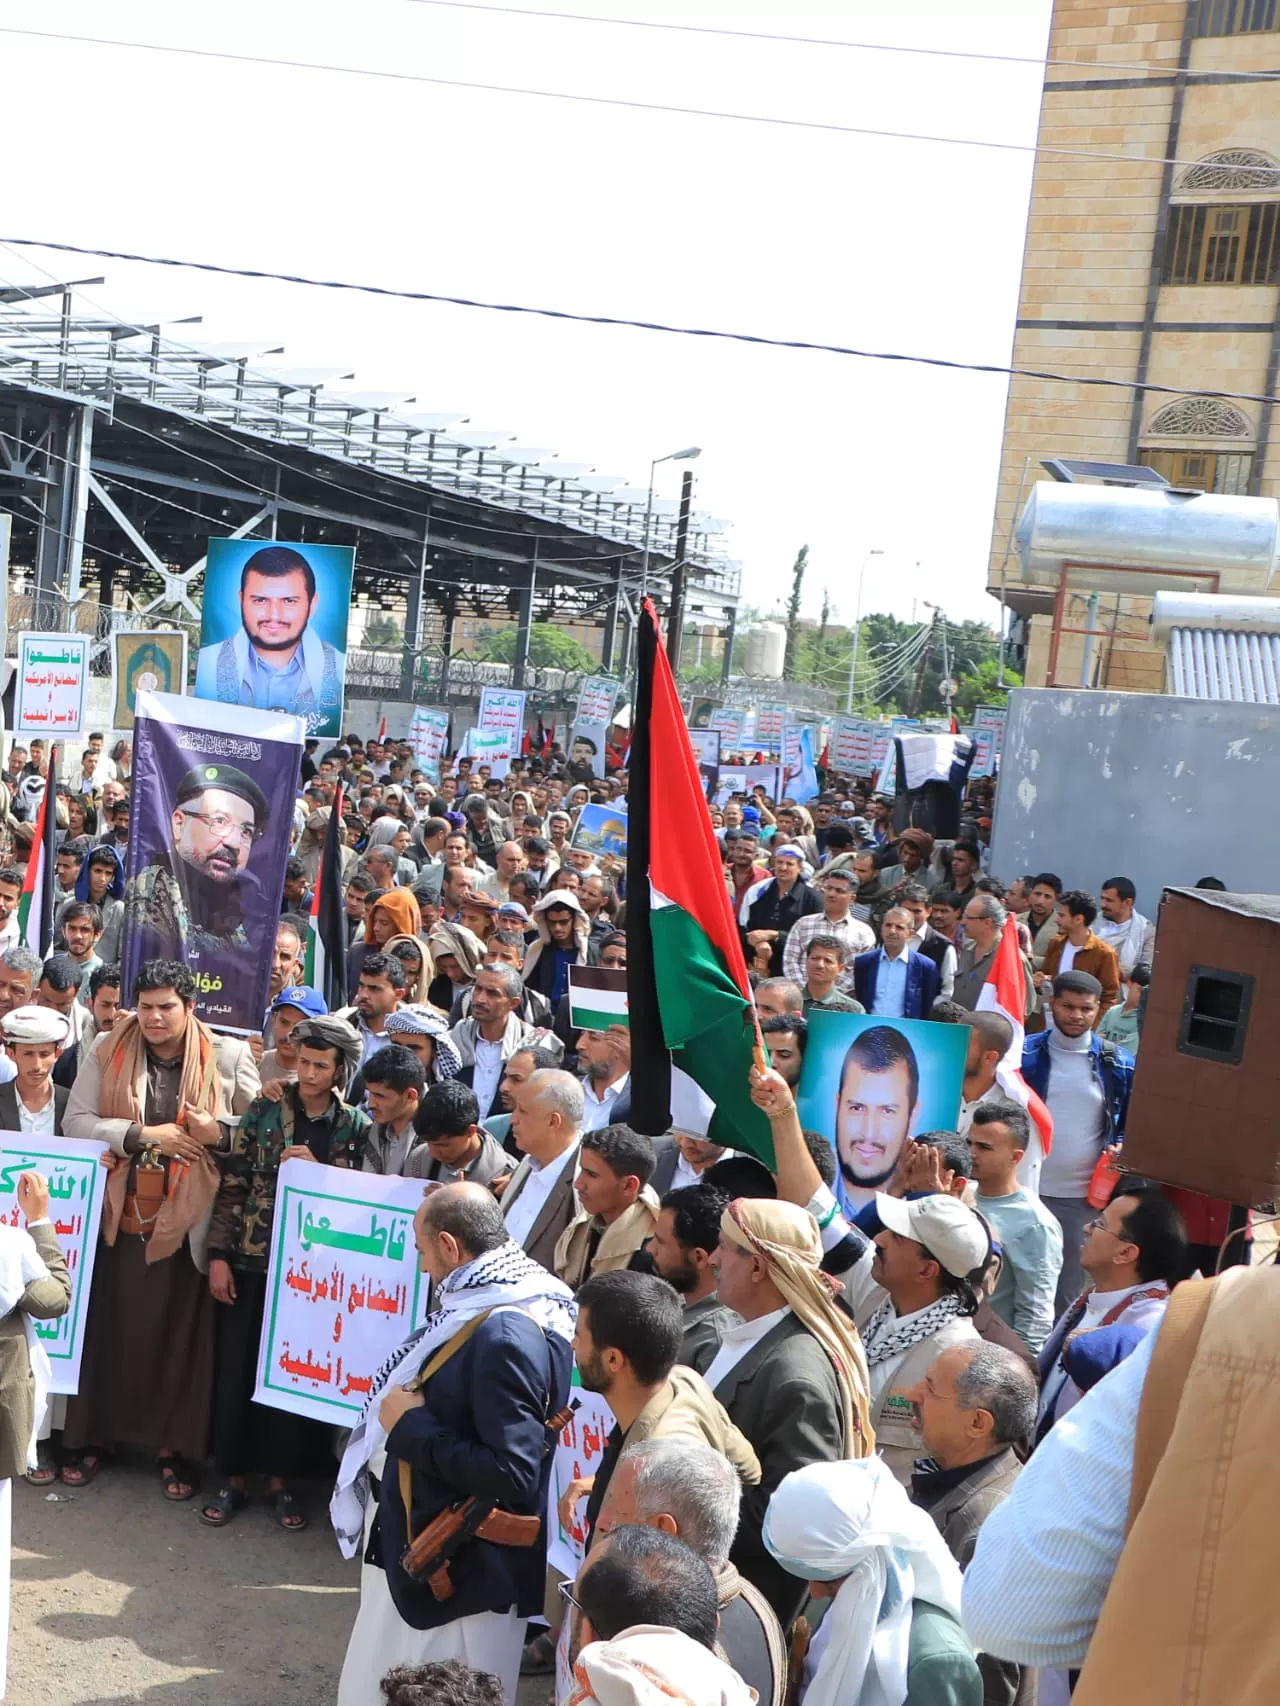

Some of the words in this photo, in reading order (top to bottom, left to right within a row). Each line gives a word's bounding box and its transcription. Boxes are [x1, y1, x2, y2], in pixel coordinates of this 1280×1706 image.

[26, 646, 81, 667] قاطعوا
[296, 1200, 408, 1262] قاطعوا
[346, 1279, 408, 1321] البضائع
[331, 1312, 343, 1343] و
[277, 1341, 373, 1396] سرائيلية
